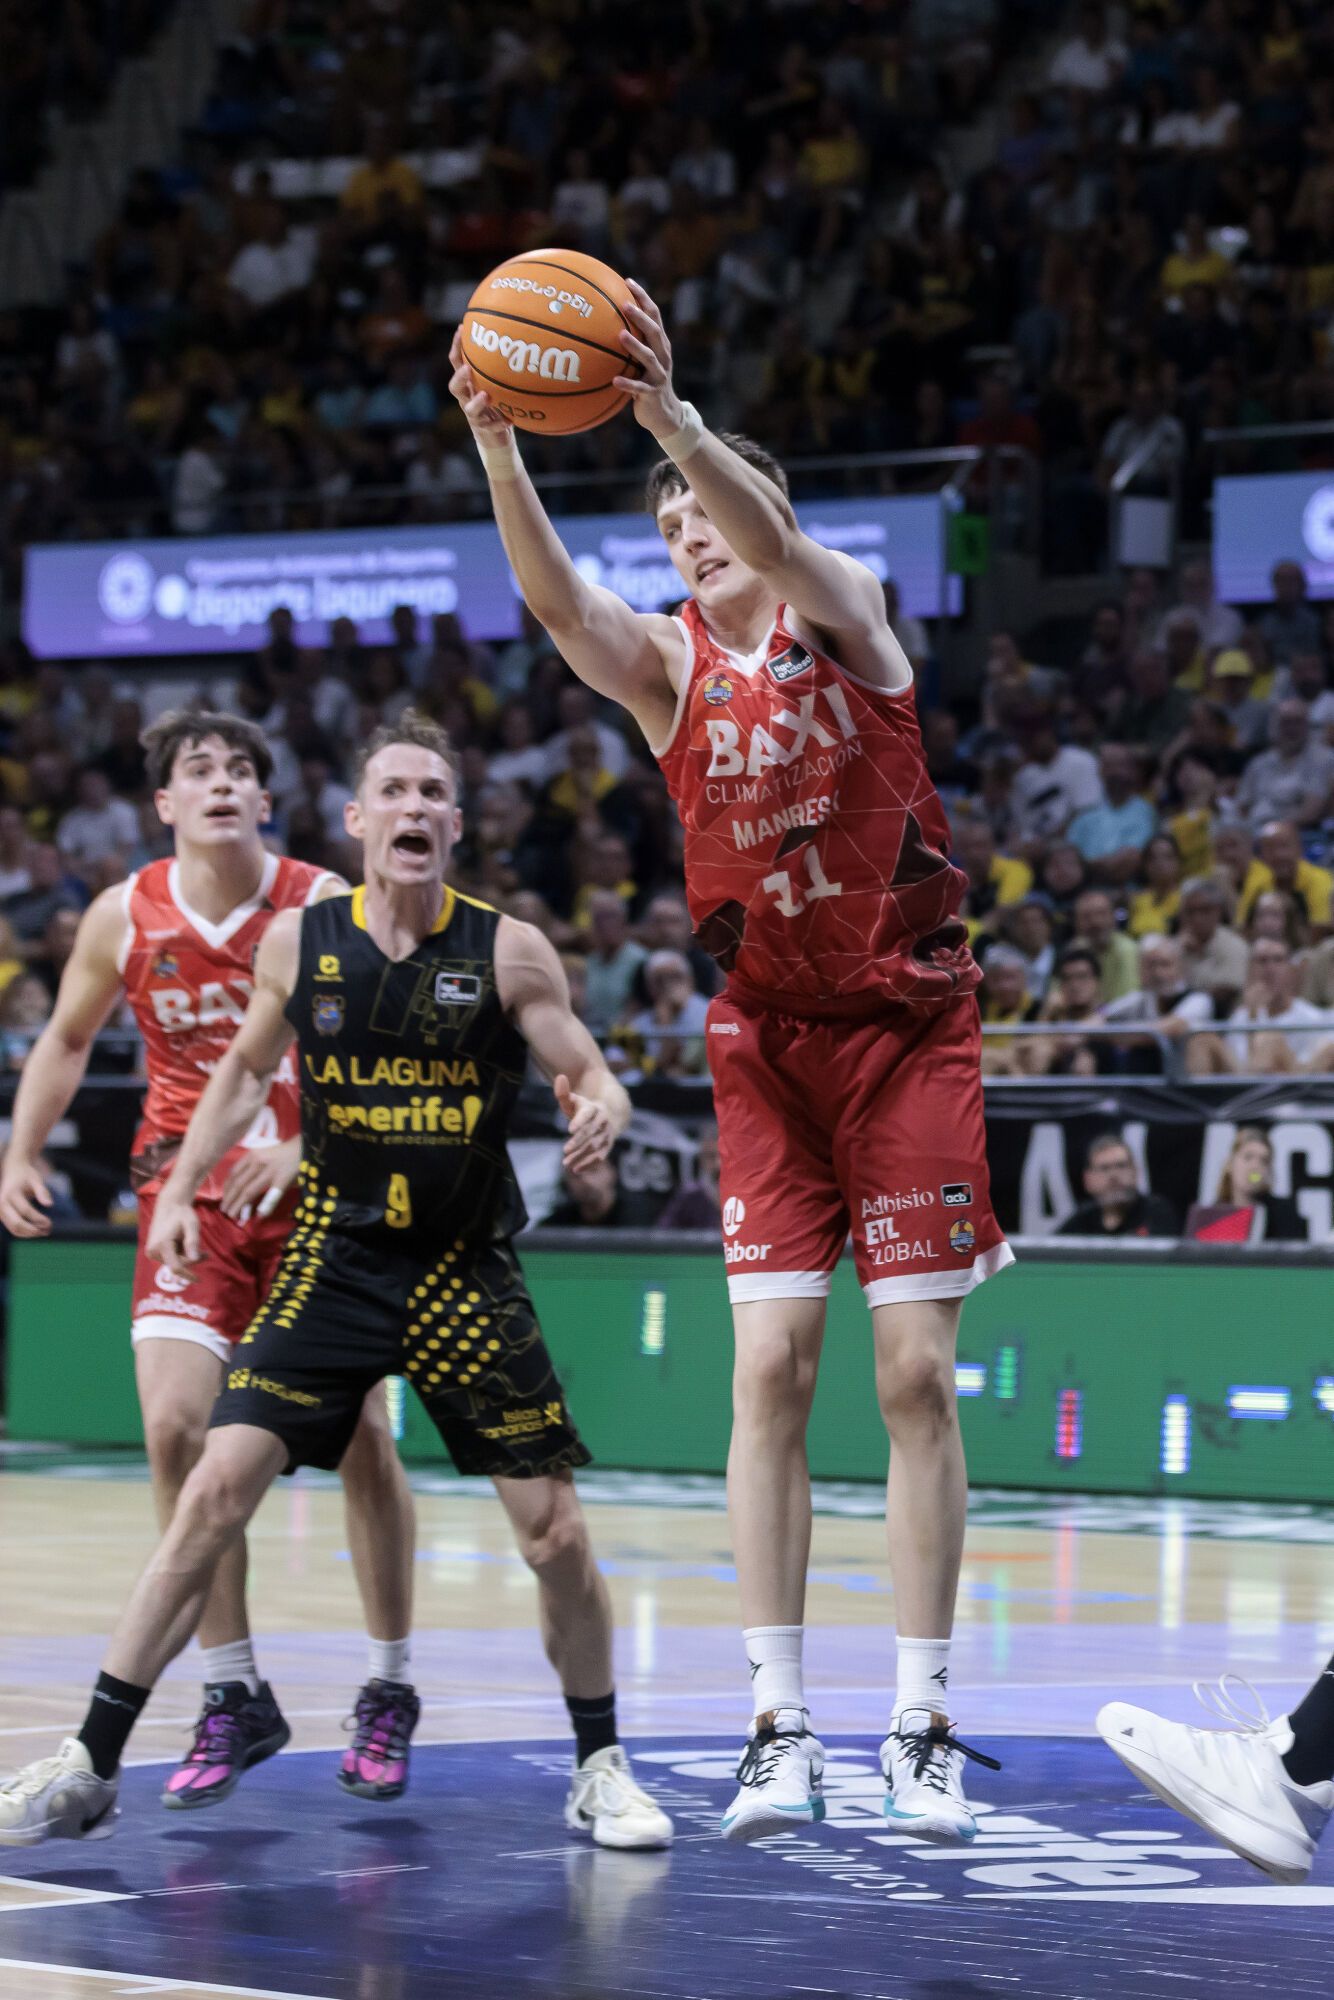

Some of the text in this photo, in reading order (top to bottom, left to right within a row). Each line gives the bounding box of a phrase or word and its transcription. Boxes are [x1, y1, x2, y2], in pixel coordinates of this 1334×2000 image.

[490, 277, 594, 318] liga endesa
[470, 320, 581, 383] Wilson
[705, 682, 858, 778] BAXI
[305, 1054, 345, 1085] LA
[350, 1056, 480, 1087] LAGUNA
[327, 1095, 483, 1145] enerife!
[384, 1172, 411, 1229] 9
[861, 1187, 935, 1219] Adhisio
[945, 1193, 967, 1204] acb
[864, 1217, 900, 1246] ETL
